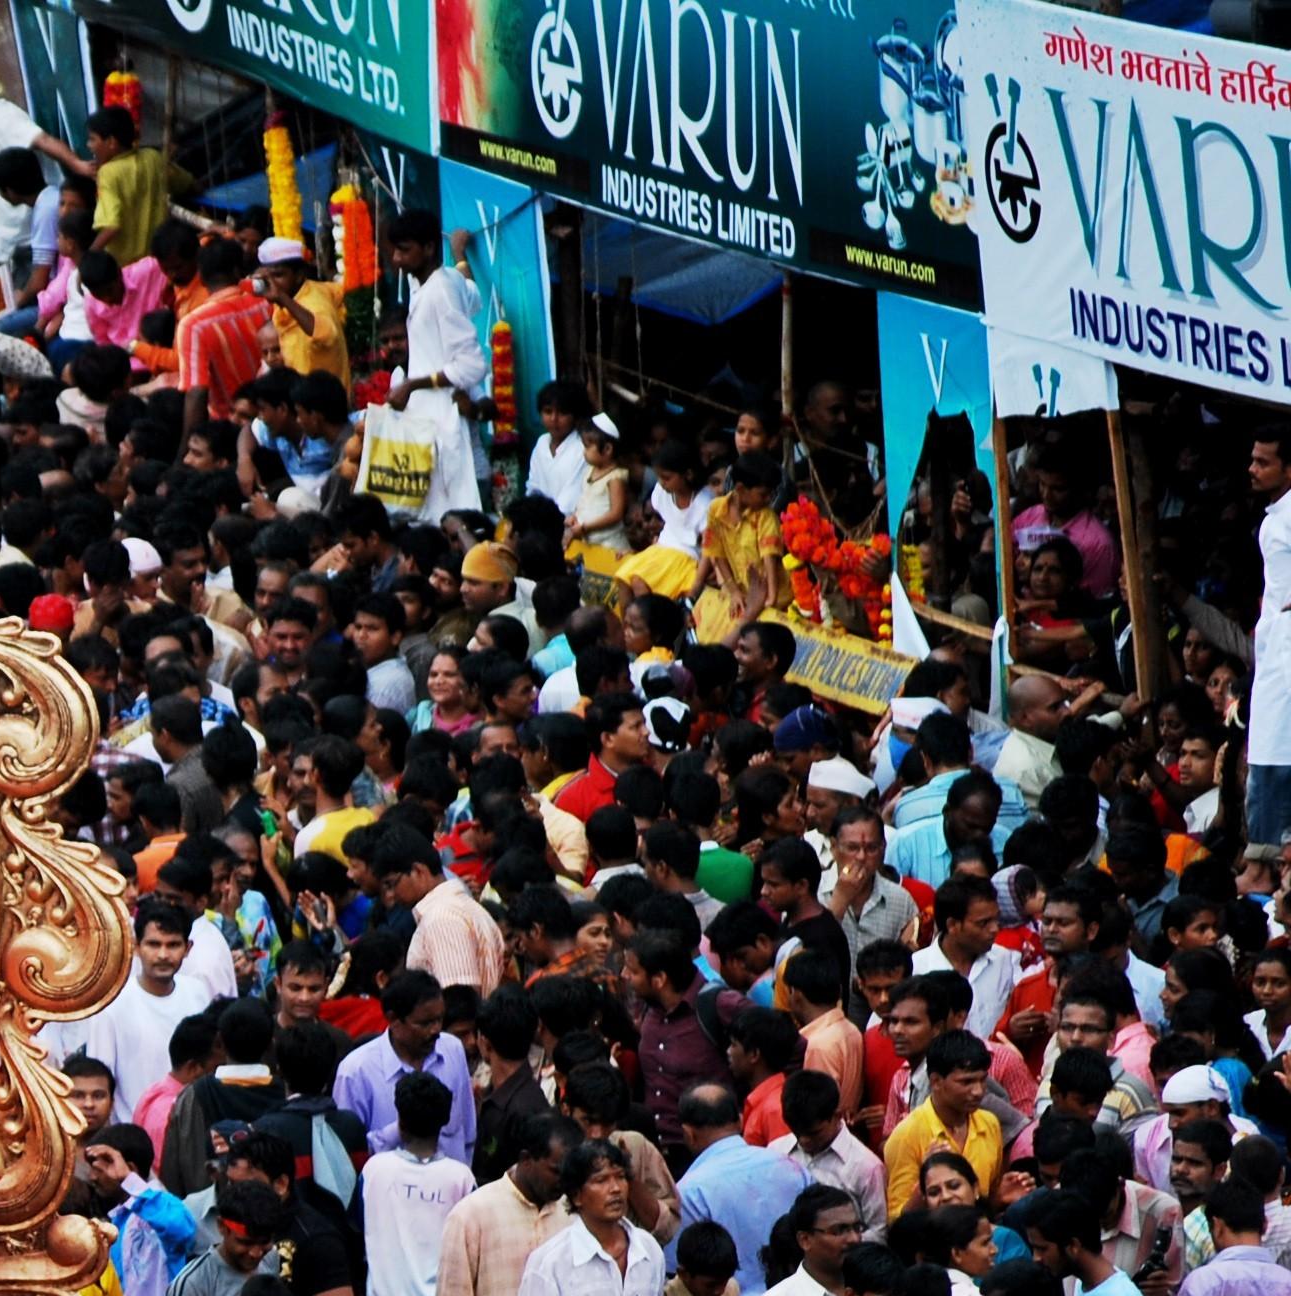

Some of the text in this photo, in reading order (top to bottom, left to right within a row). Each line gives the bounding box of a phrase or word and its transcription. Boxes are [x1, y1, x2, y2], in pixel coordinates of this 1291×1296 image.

[226, 5, 354, 96] INDUSTRIES
[357, 56, 405, 116] LTD.
[592, 0, 804, 207] VARUN
[1043, 26, 1114, 76] गणेश
[1120, 49, 1212, 96] भक्तांचे
[479, 138, 558, 176] www.varun.com
[601, 164, 796, 258] INDUSTRIES LIMITED
[845, 245, 936, 284] www.varun.com
[1070, 287, 1269, 384] INDUSTRIES
